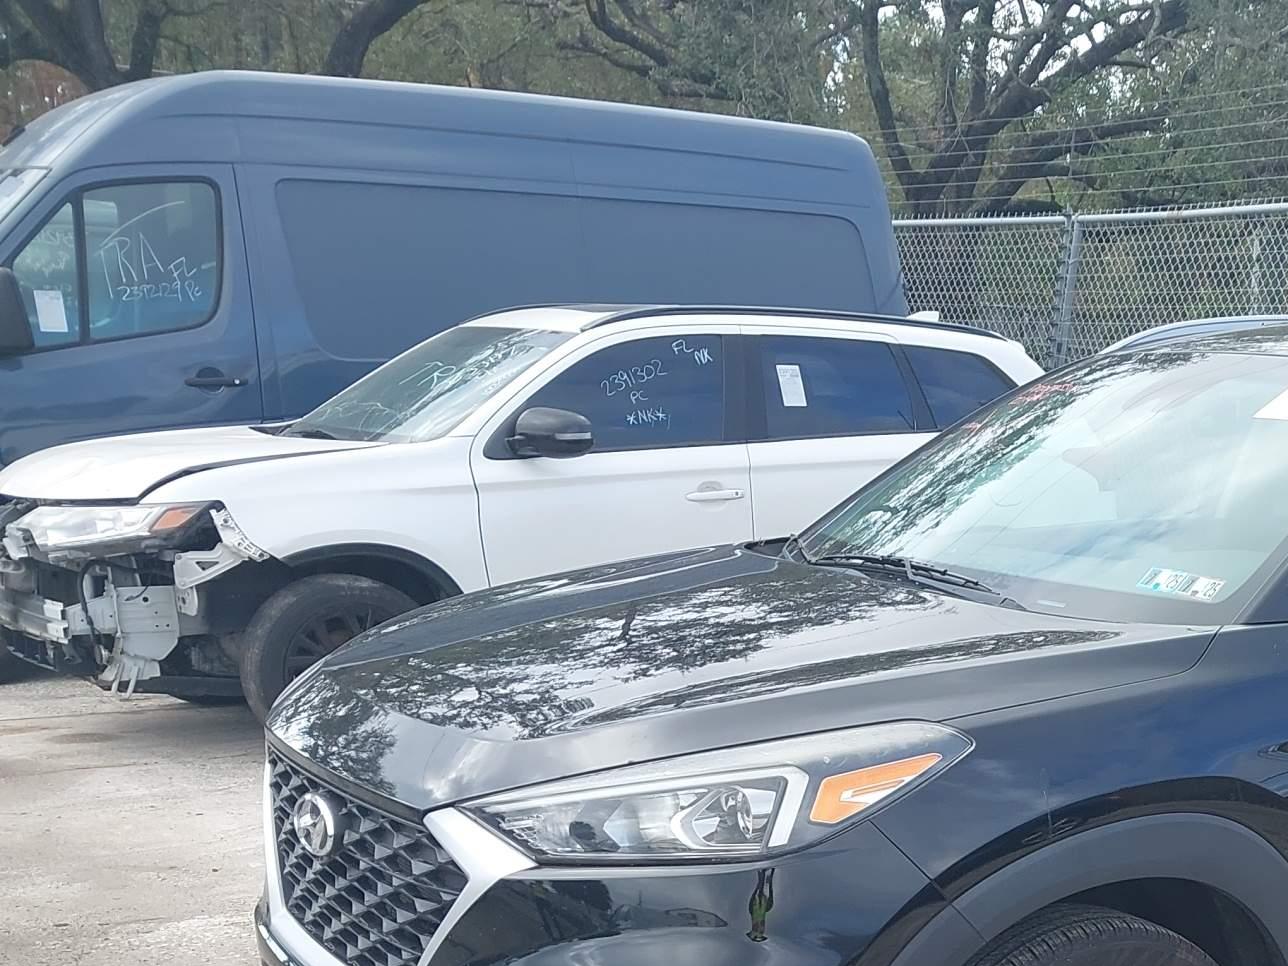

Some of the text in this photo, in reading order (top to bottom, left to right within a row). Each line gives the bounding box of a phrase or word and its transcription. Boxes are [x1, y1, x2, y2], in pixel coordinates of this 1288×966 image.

[671, 339, 713, 366] FL NK
[600, 359, 668, 397] 2391302
